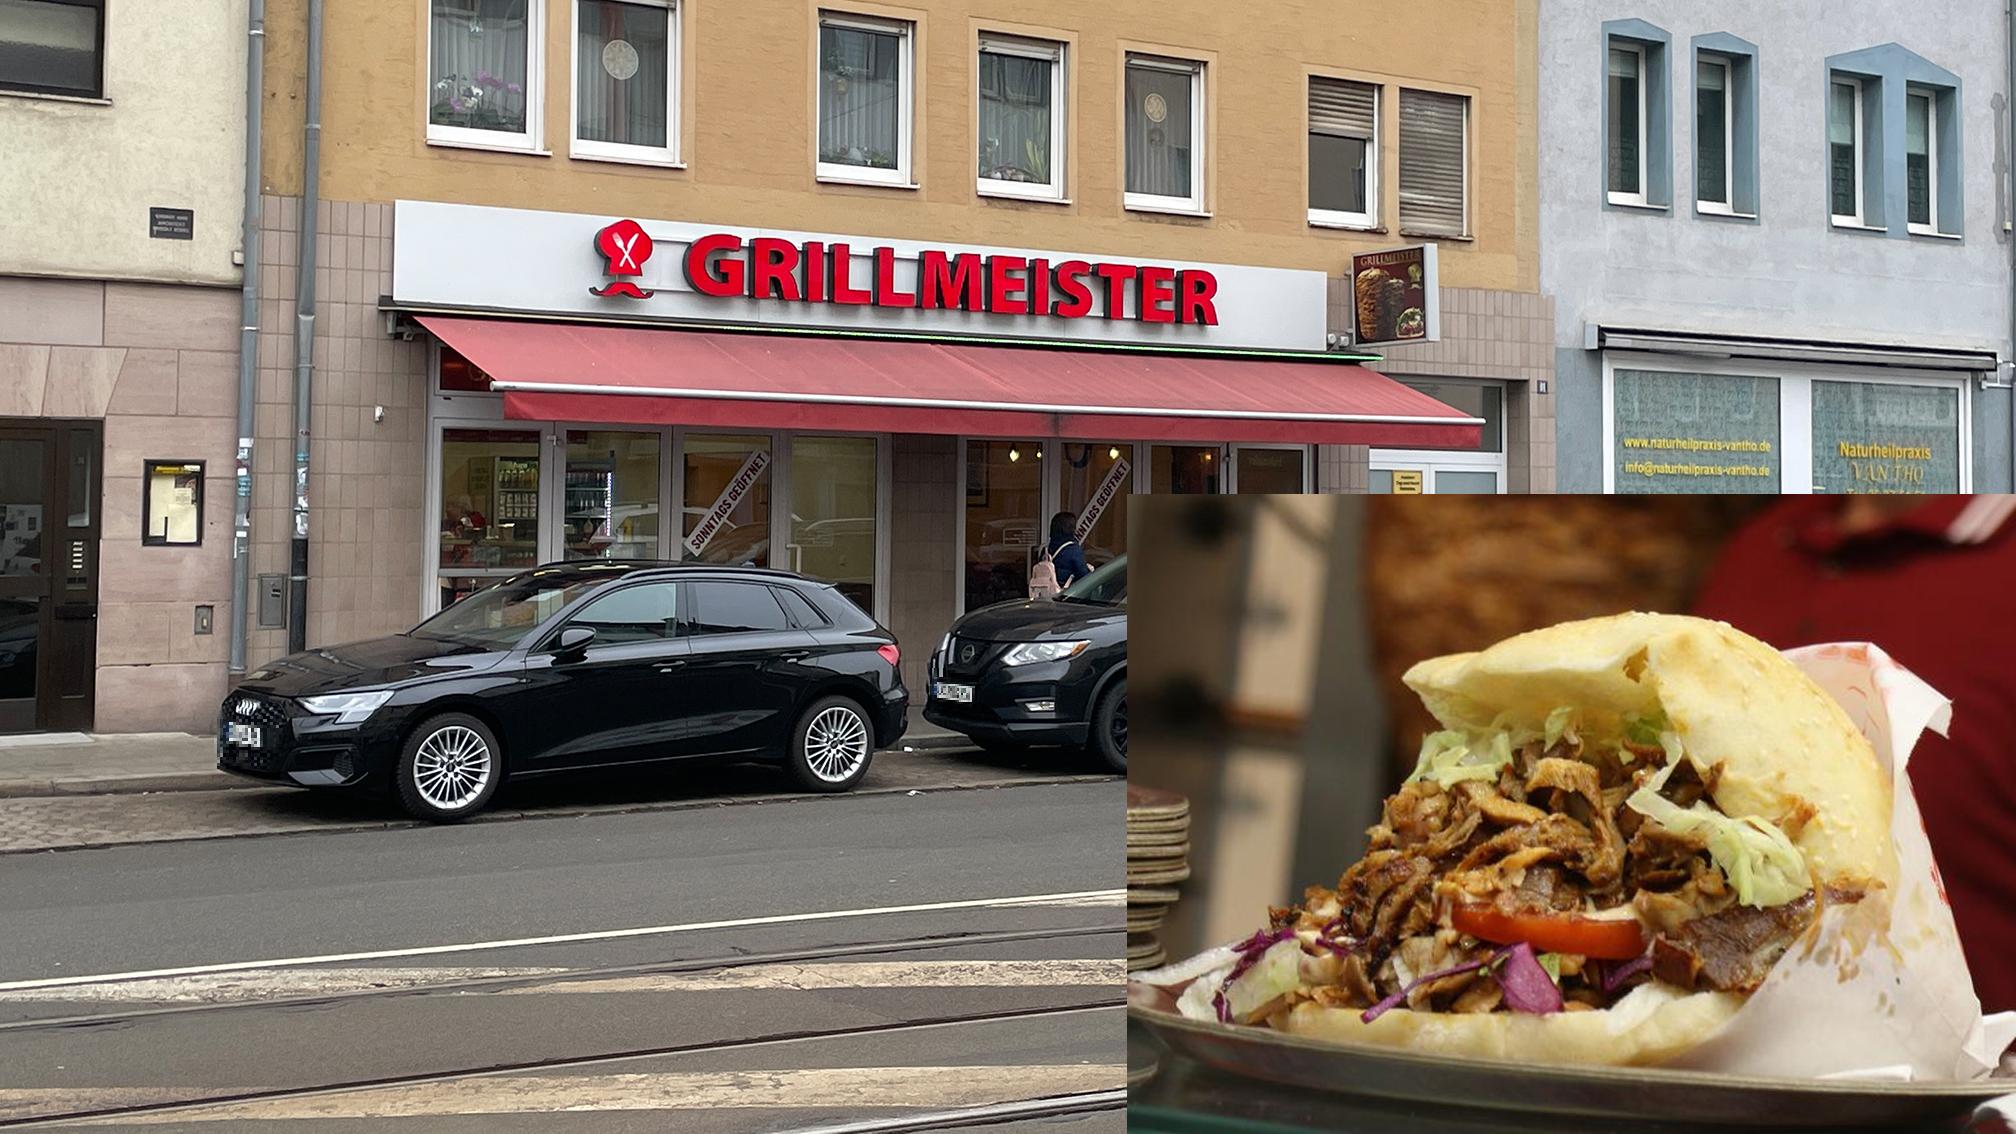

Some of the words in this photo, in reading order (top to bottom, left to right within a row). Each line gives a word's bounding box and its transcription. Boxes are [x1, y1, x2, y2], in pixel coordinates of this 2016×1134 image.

[1360, 249, 1420, 267] GRILLMEISTER
[683, 233, 1219, 326] GRILLMEISTER
[1623, 437, 1771, 453] www.naturheilpraxis-vantho.de
[1839, 440, 1932, 461] Naturheilpraxis
[1625, 460, 1770, 477] info@naturheilpraxis-vantho.de
[1852, 462, 1890, 483] VAN
[1893, 463, 1924, 484] THO
[1096, 462, 1128, 507] GEÖFFNET
[691, 499, 732, 549] SONNTAGS
[728, 454, 766, 502] GEÖFFNET
